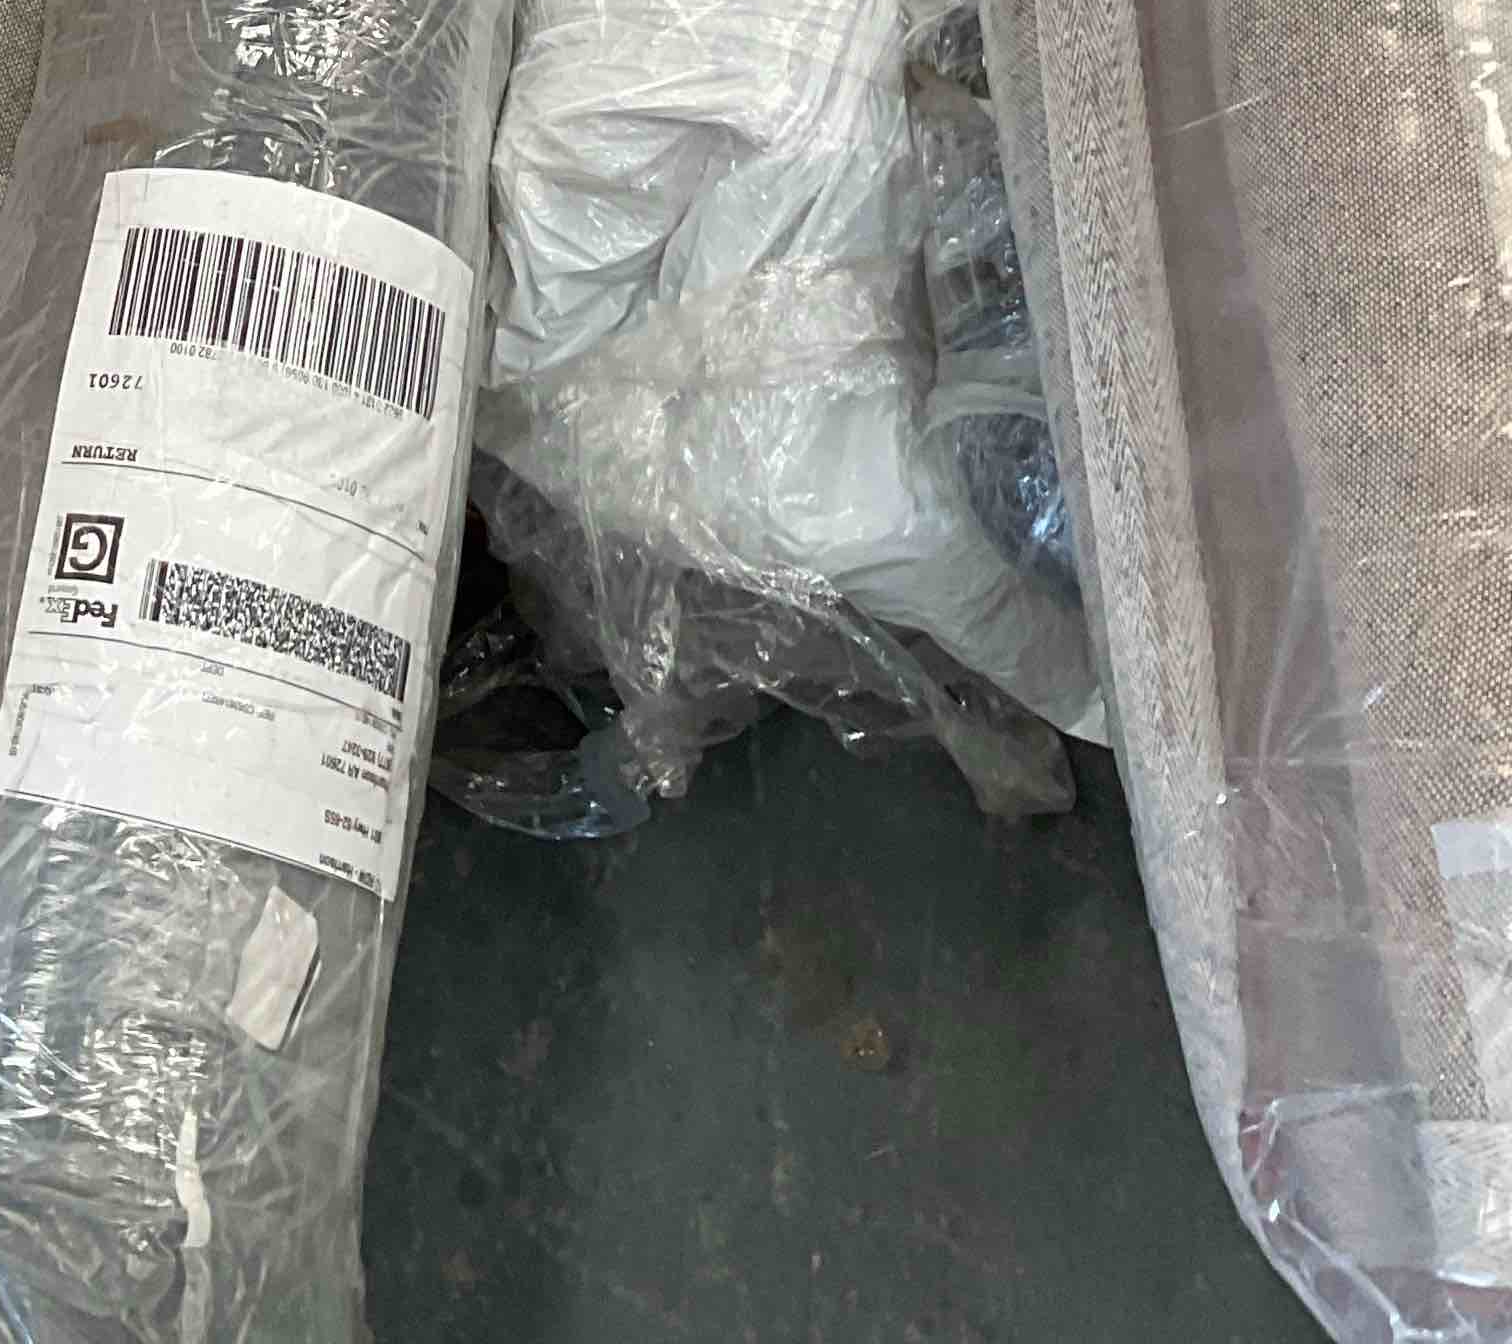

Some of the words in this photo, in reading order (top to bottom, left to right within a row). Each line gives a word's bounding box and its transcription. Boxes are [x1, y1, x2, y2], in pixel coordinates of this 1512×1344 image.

[88, 370, 143, 392] 72601
[71, 443, 138, 464] RETURN
[32, 593, 119, 630] FedEx
